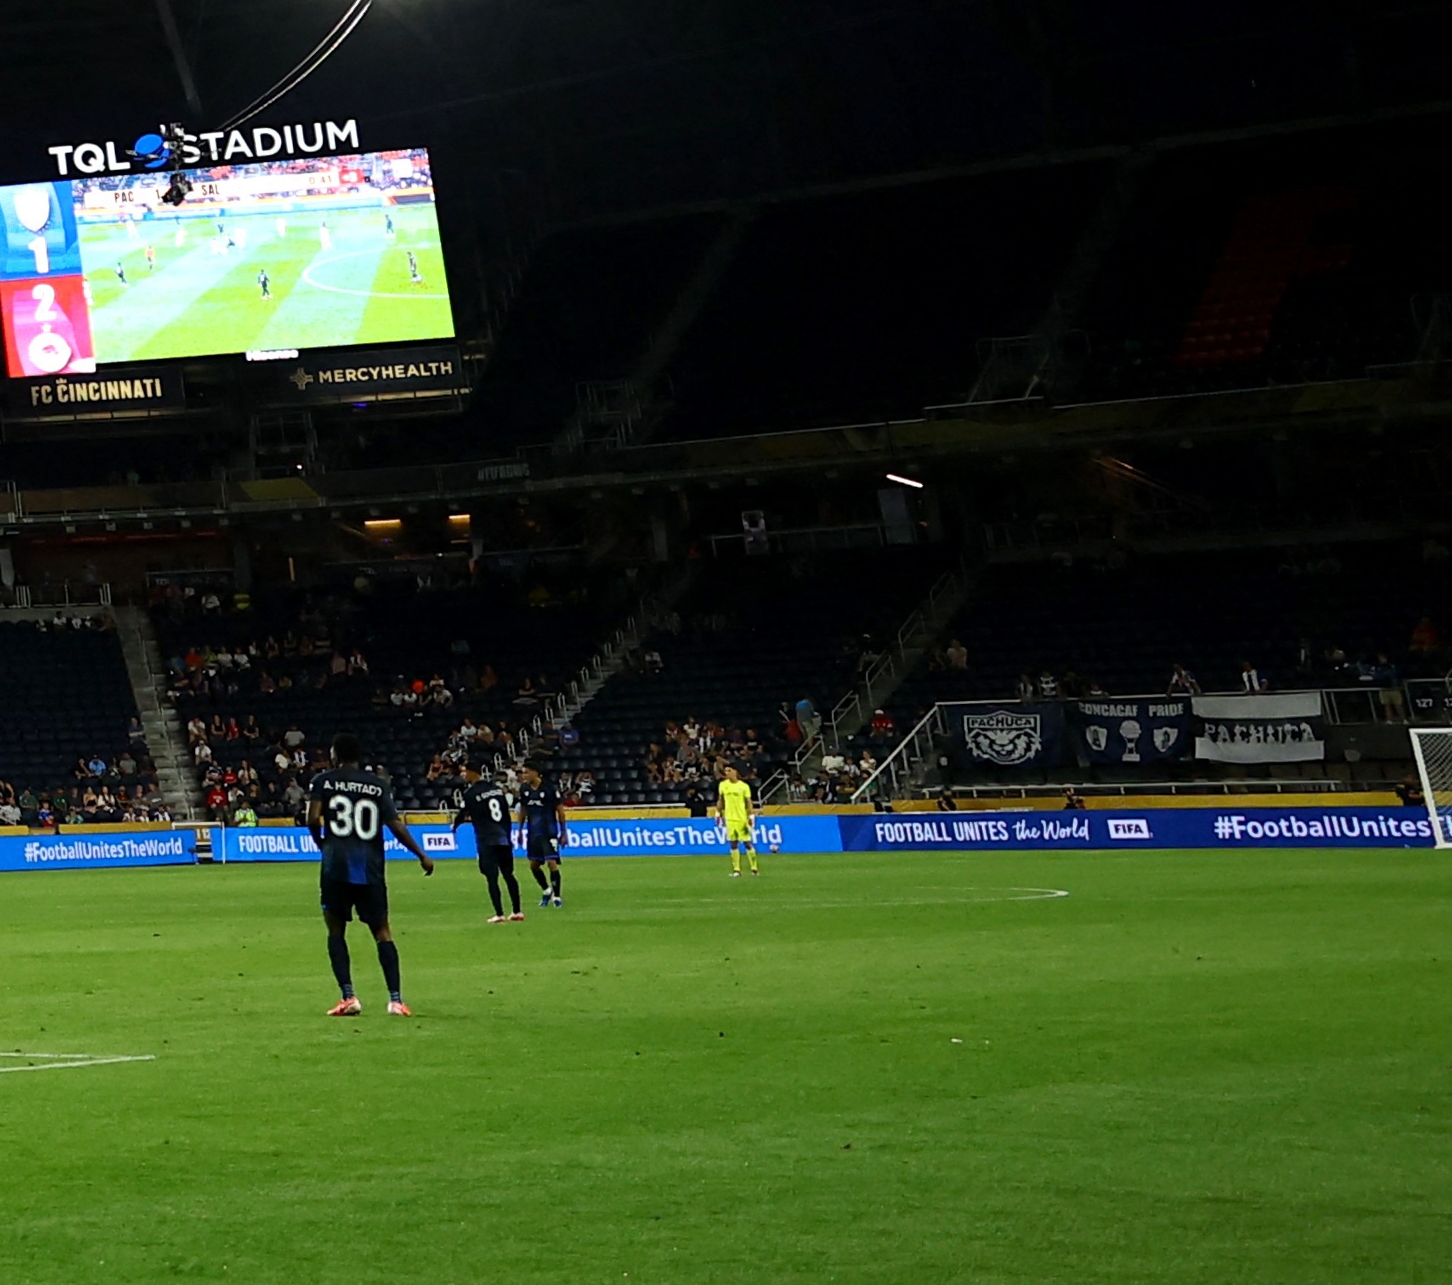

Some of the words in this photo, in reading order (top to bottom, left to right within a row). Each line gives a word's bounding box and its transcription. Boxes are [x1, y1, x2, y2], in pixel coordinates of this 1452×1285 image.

[49, 142, 131, 176] TQL
[183, 119, 360, 164] STADIUM
[114, 191, 134, 203] PAC
[28, 236, 50, 274] 1
[32, 284, 57, 322] 2
[31, 384, 53, 406] FC
[56, 379, 162, 404] CINCINNATI
[1148, 702, 1184, 717] PRIDE
[970, 716, 1034, 729] PACHUCA
[329, 794, 379, 841] 30
[488, 797, 504, 823] 8
[427, 836, 451, 847] FIFA
[875, 821, 951, 844] FOOTBALL
[952, 820, 1009, 841] UNITES
[1011, 819, 1041, 841] the
[1041, 814, 1090, 841] World
[1114, 823, 1144, 835] FIFA
[25, 838, 183, 862] #FootballUnitesTheWorld
[239, 835, 299, 854] FOOTBALL
